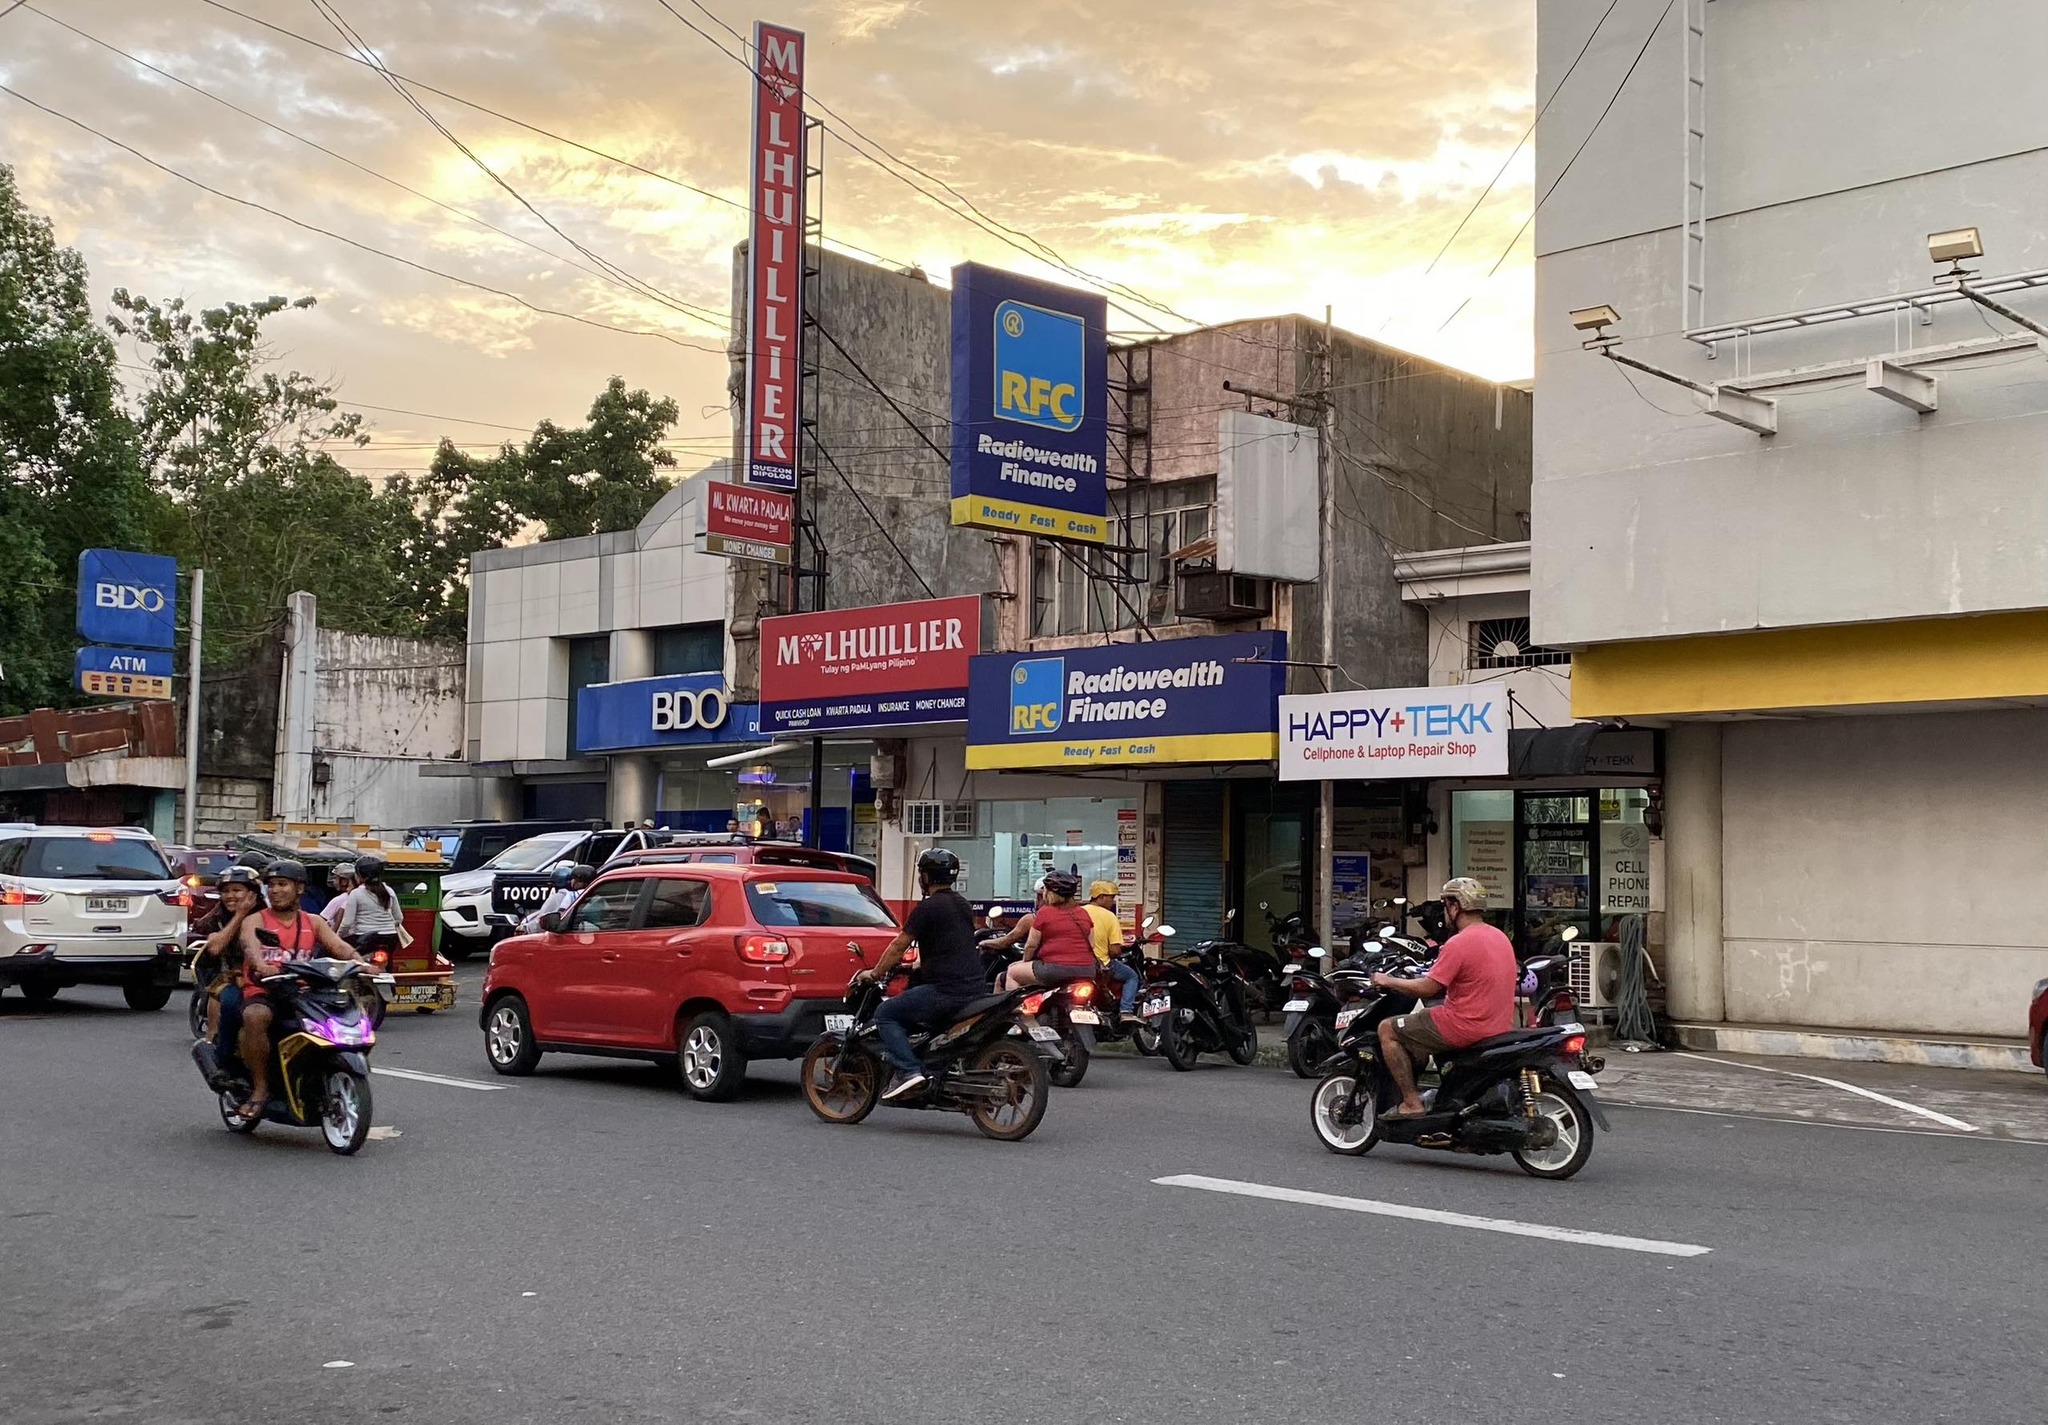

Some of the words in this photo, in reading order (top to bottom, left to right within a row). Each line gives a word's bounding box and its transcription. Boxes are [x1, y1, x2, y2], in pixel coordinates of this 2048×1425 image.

[1001, 370, 1076, 424] RFC
[977, 433, 1097, 474] Radiowealth
[752, 464, 792, 474] QUEZON
[752, 470, 792, 480] DIPOLOG
[1000, 462, 1077, 493] Finance
[713, 491, 724, 510] ML
[726, 493, 759, 516] KWARTA
[760, 498, 789, 522] PADALA
[982, 505, 1020, 524] Ready
[1030, 513, 1056, 528] Fast
[1068, 520, 1097, 535] Cash
[723, 539, 746, 554] MONEY
[746, 543, 776, 560] CHANGER
[96, 582, 164, 612] BDO
[109, 655, 146, 672] ATM
[820, 664, 839, 675] Tulay
[840, 665, 850, 674] ng
[851, 662, 887, 672] PaMLyang
[888, 657, 916, 668] Pilipino
[1067, 660, 1225, 695] Radiowealth
[652, 687, 727, 730] BDO
[775, 710, 792, 721] QUICK
[792, 709, 807, 719] CASH
[807, 707, 821, 718] LOAN
[826, 705, 849, 716] KWARTA
[849, 704, 872, 715] PADALA
[878, 701, 910, 713] INSURANCE
[915, 699, 937, 710] MONEY
[937, 697, 965, 709] CHANGER
[1013, 701, 1058, 730] RFC
[1067, 697, 1167, 723] Finance
[1063, 746, 1094, 758] Ready
[1100, 745, 1122, 755] Fast
[1129, 744, 1156, 755] Cash
[1303, 745, 1355, 763] Cellphone
[1357, 746, 1365, 758] &
[1368, 744, 1406, 760] Laptop
[1408, 742, 1444, 759] Repair
[1447, 741, 1477, 757] Shop
[1563, 828, 1583, 837] Repair
[1548, 856, 1568, 866] OPEN
[1616, 861, 1645, 873] CELL
